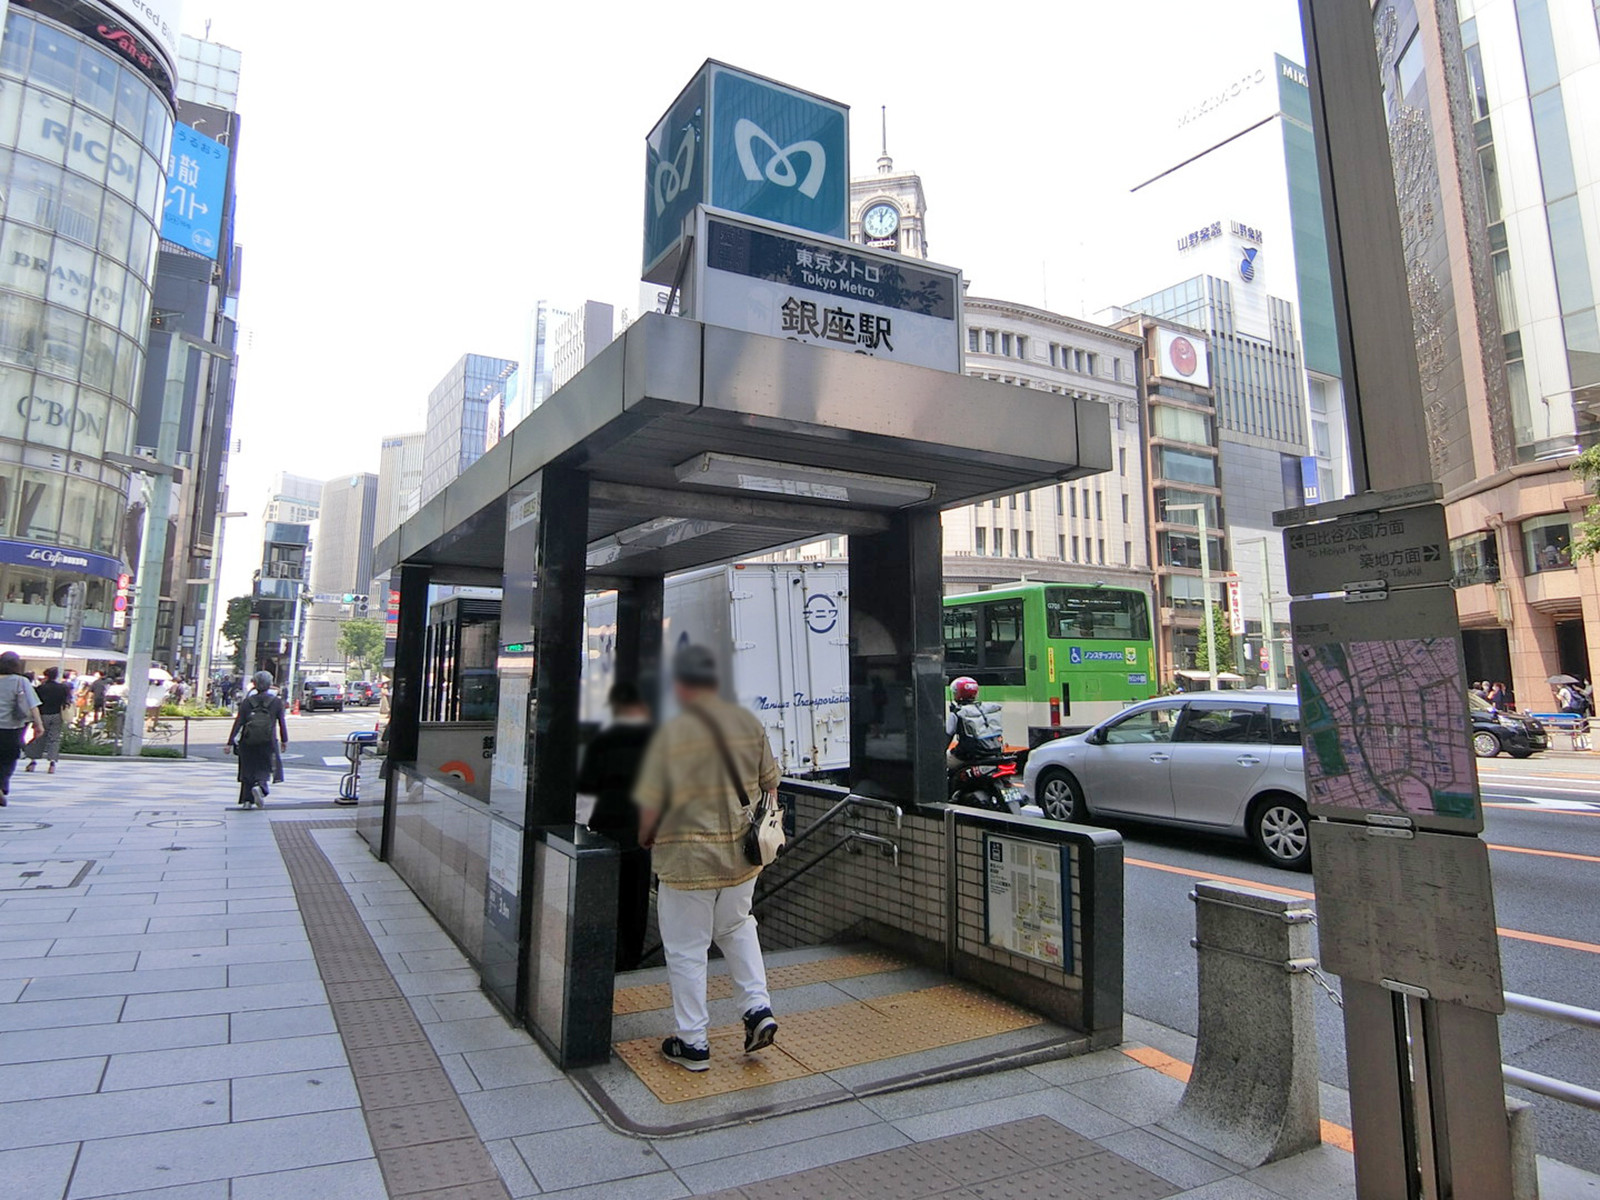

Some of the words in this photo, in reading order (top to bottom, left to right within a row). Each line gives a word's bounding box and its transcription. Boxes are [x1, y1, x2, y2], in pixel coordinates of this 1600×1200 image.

[795, 249, 880, 283] 東京メトロ
[801, 270, 837, 291] Tokyo
[839, 279, 876, 298] Metro
[781, 296, 894, 353] 銀座駅
[1305, 520, 1405, 547] 日比谷公園方面
[1359, 547, 1422, 569] 築地方面
